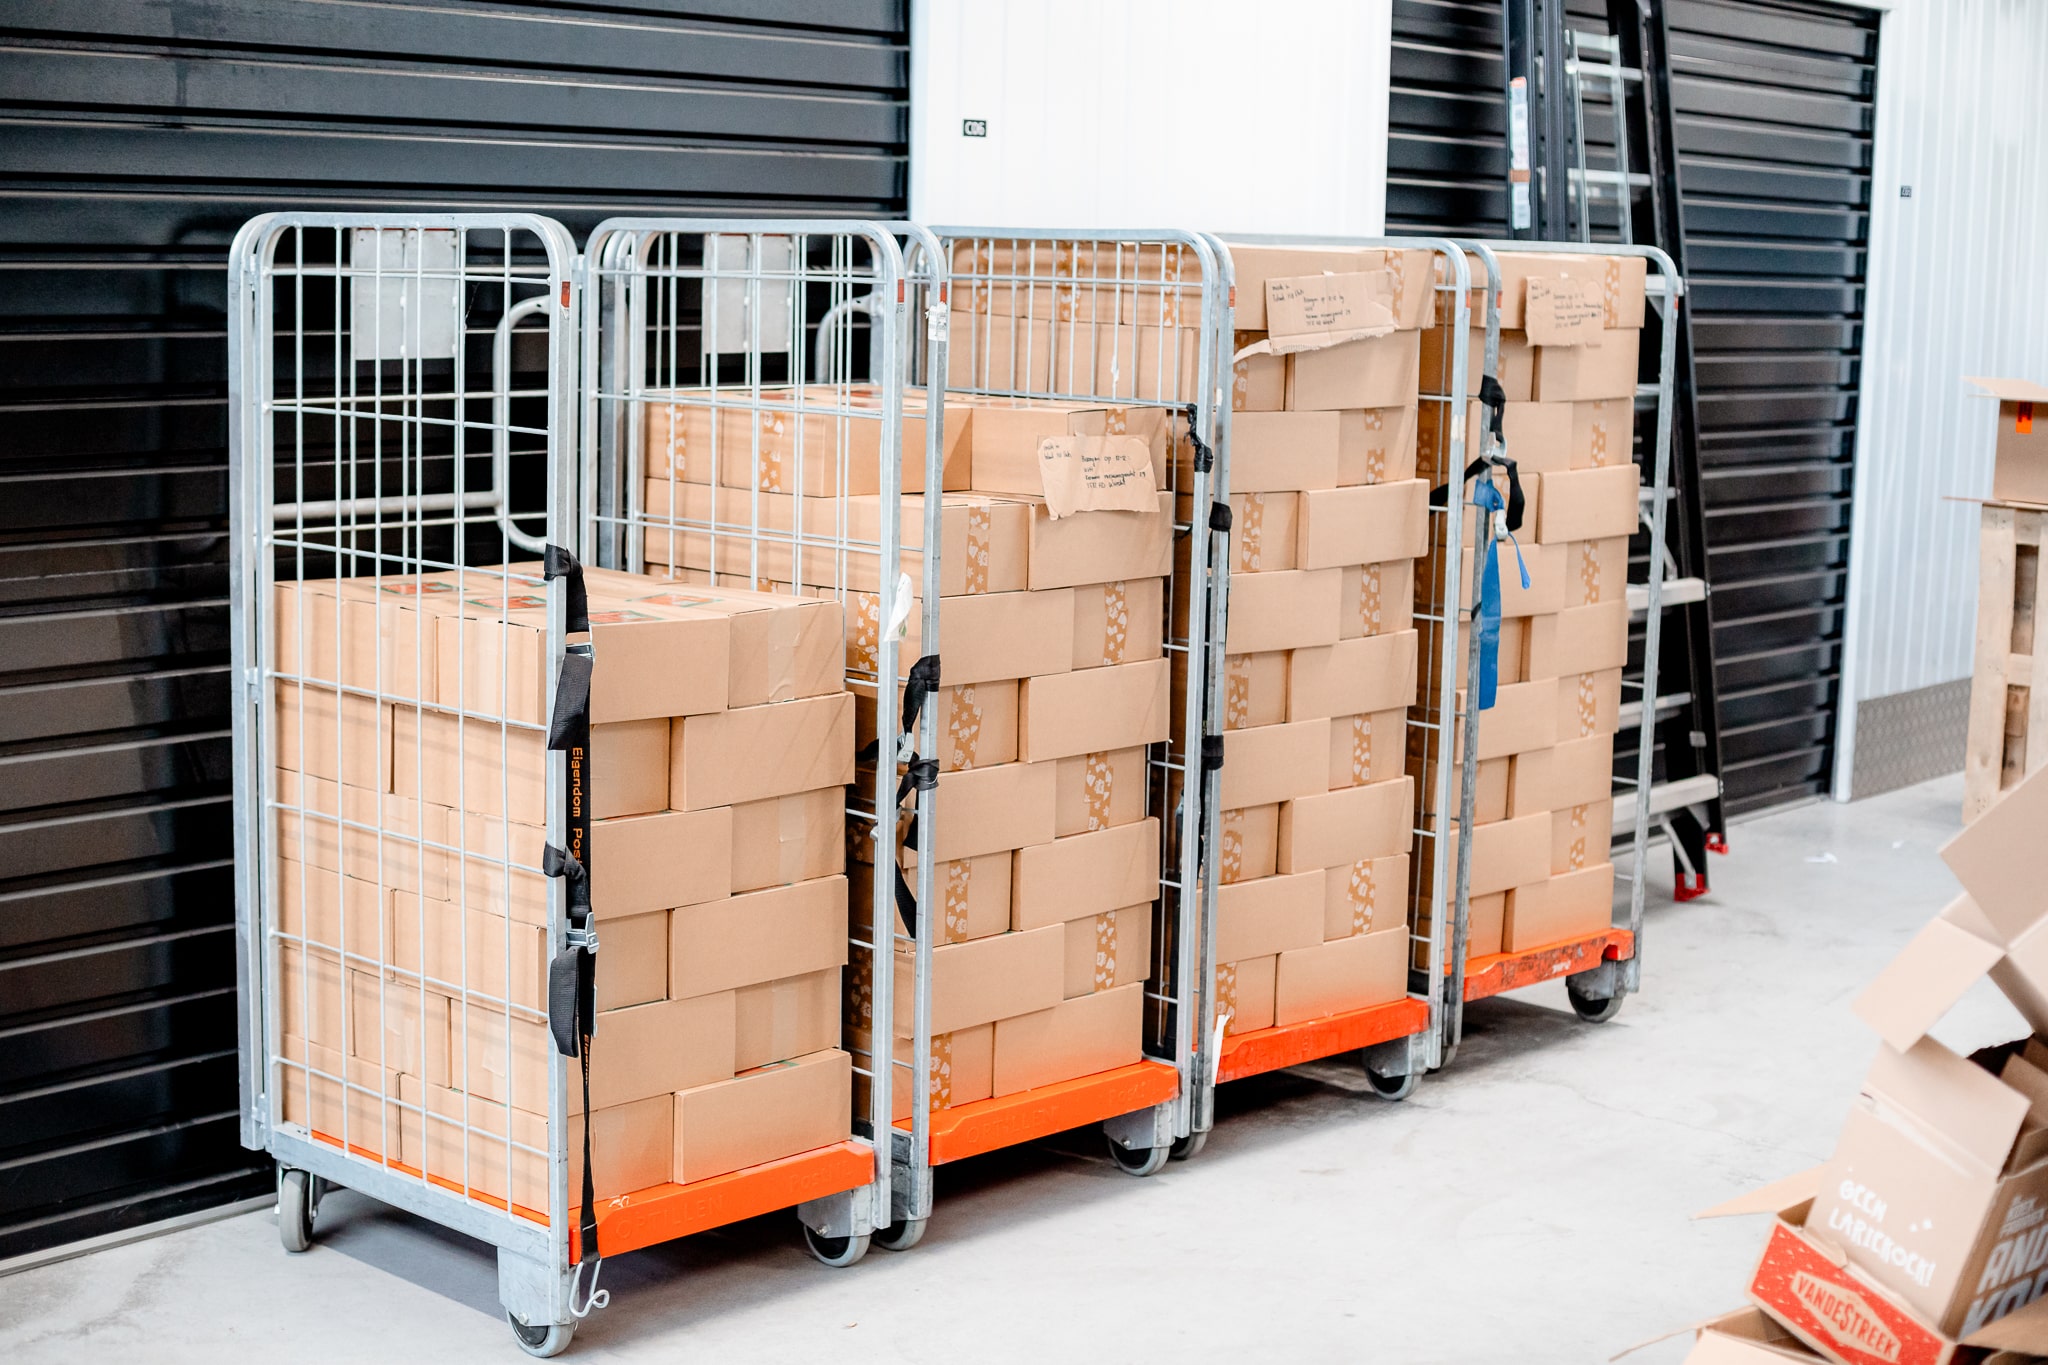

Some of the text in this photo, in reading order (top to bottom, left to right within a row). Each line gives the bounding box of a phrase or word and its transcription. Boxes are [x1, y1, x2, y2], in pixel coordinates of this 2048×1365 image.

[571, 747, 583, 817] Eigendom
[616, 1193, 723, 1239] OPTILLEN
[1839, 1178, 1888, 1223] GEEN
[1798, 1275, 1898, 1358] VANDESTREEK
